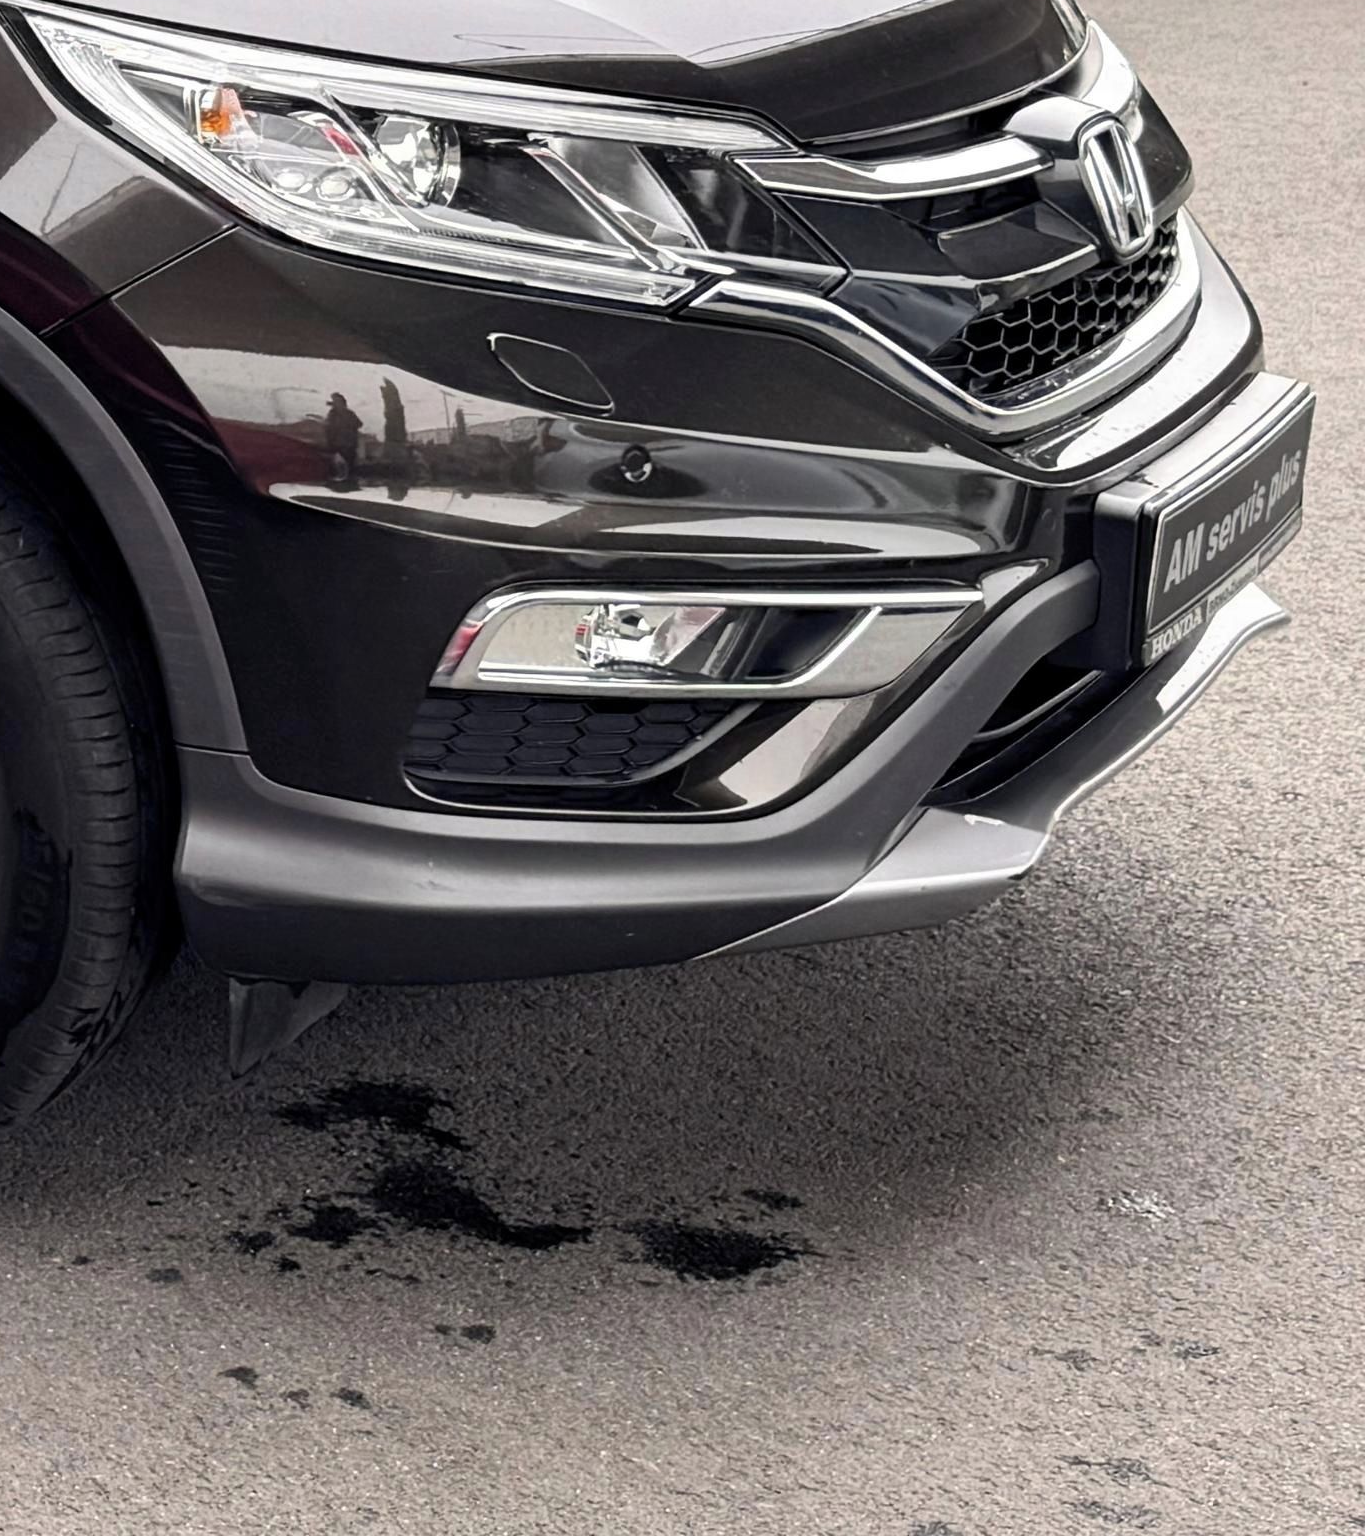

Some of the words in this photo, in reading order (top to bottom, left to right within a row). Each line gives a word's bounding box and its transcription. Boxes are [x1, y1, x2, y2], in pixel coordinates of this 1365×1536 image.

[1163, 522, 1205, 593] AM
[1206, 479, 1266, 561] servis
[1265, 449, 1302, 523] plus
[1151, 606, 1203, 660] HONDA
